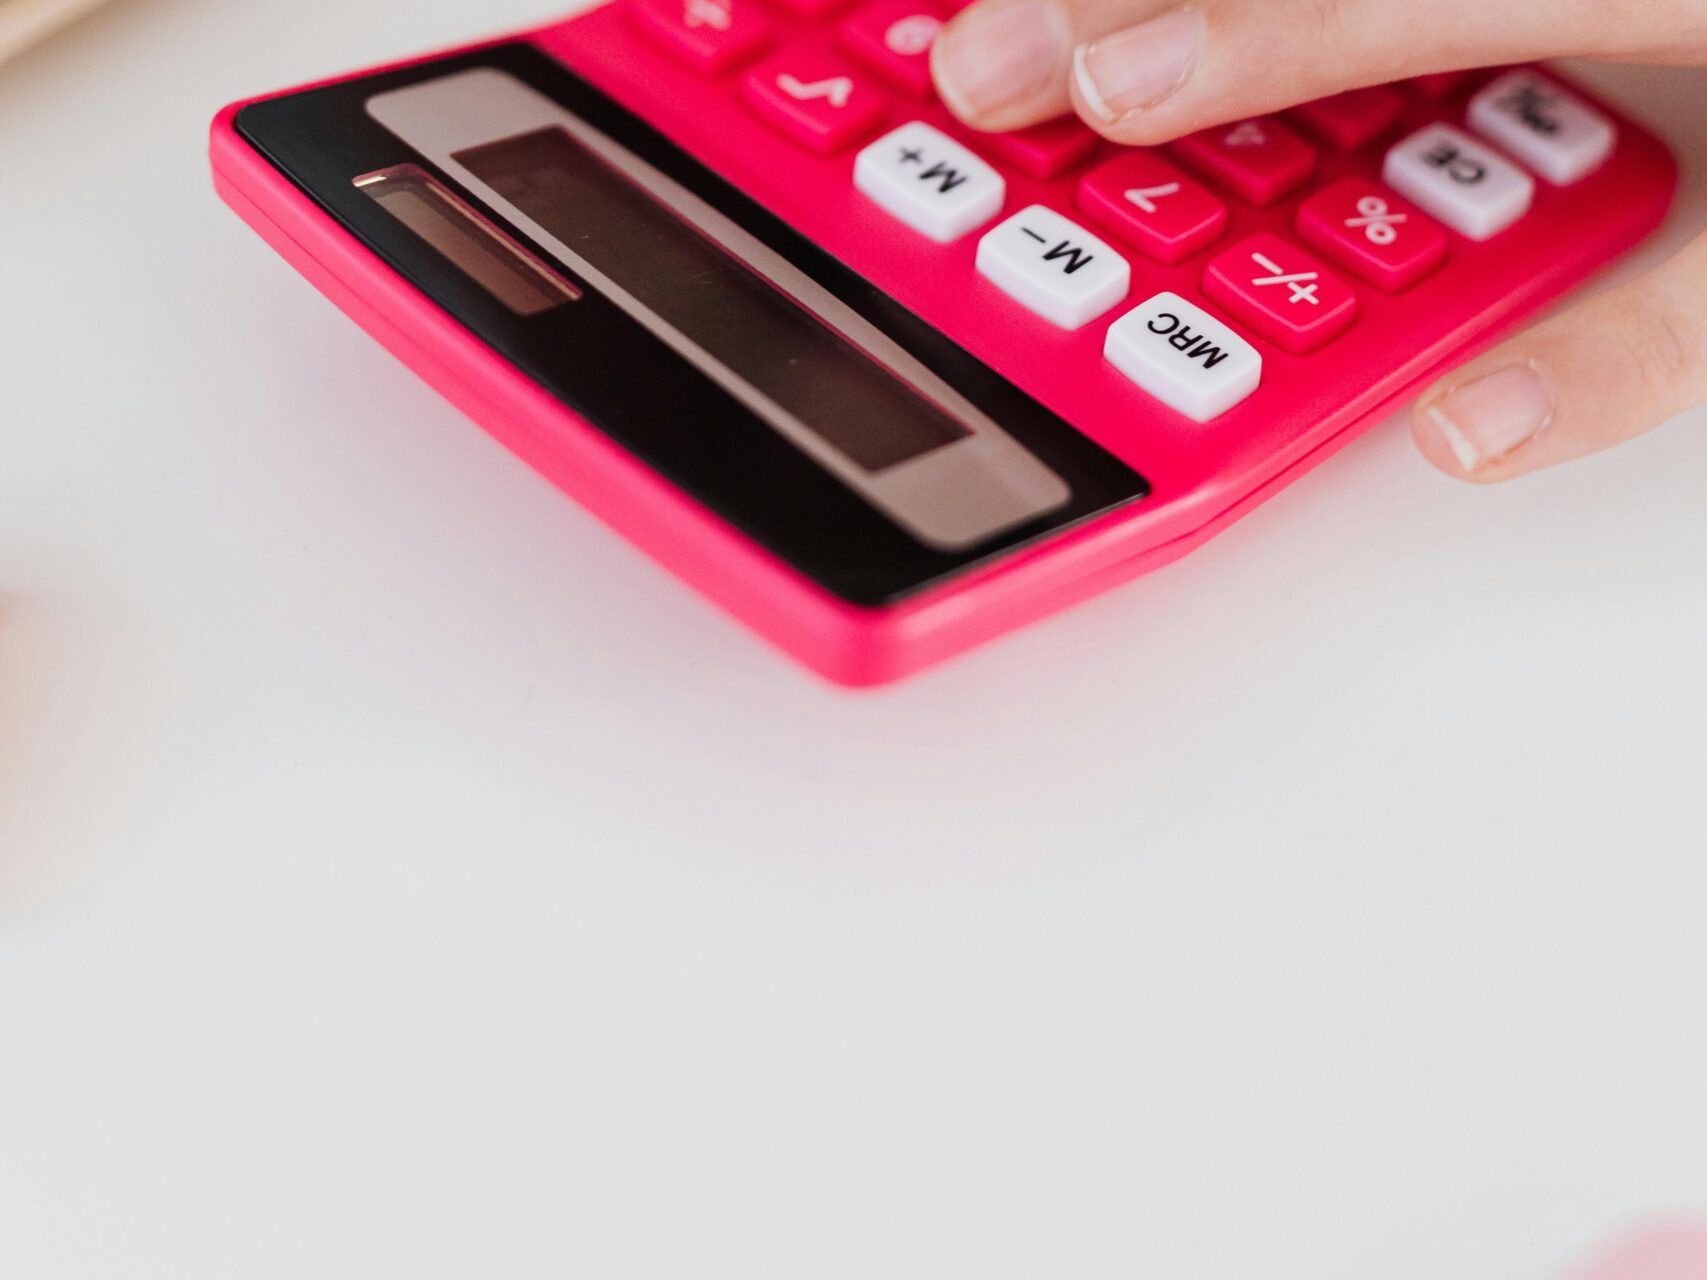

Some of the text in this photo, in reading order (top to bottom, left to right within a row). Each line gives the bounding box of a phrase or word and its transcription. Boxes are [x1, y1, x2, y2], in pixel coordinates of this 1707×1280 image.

[899, 146, 968, 194] M+
[1422, 141, 1487, 186] CE
[1123, 181, 1181, 214] 7
[1343, 195, 1408, 246] %
[1146, 312, 1230, 370] MRC
